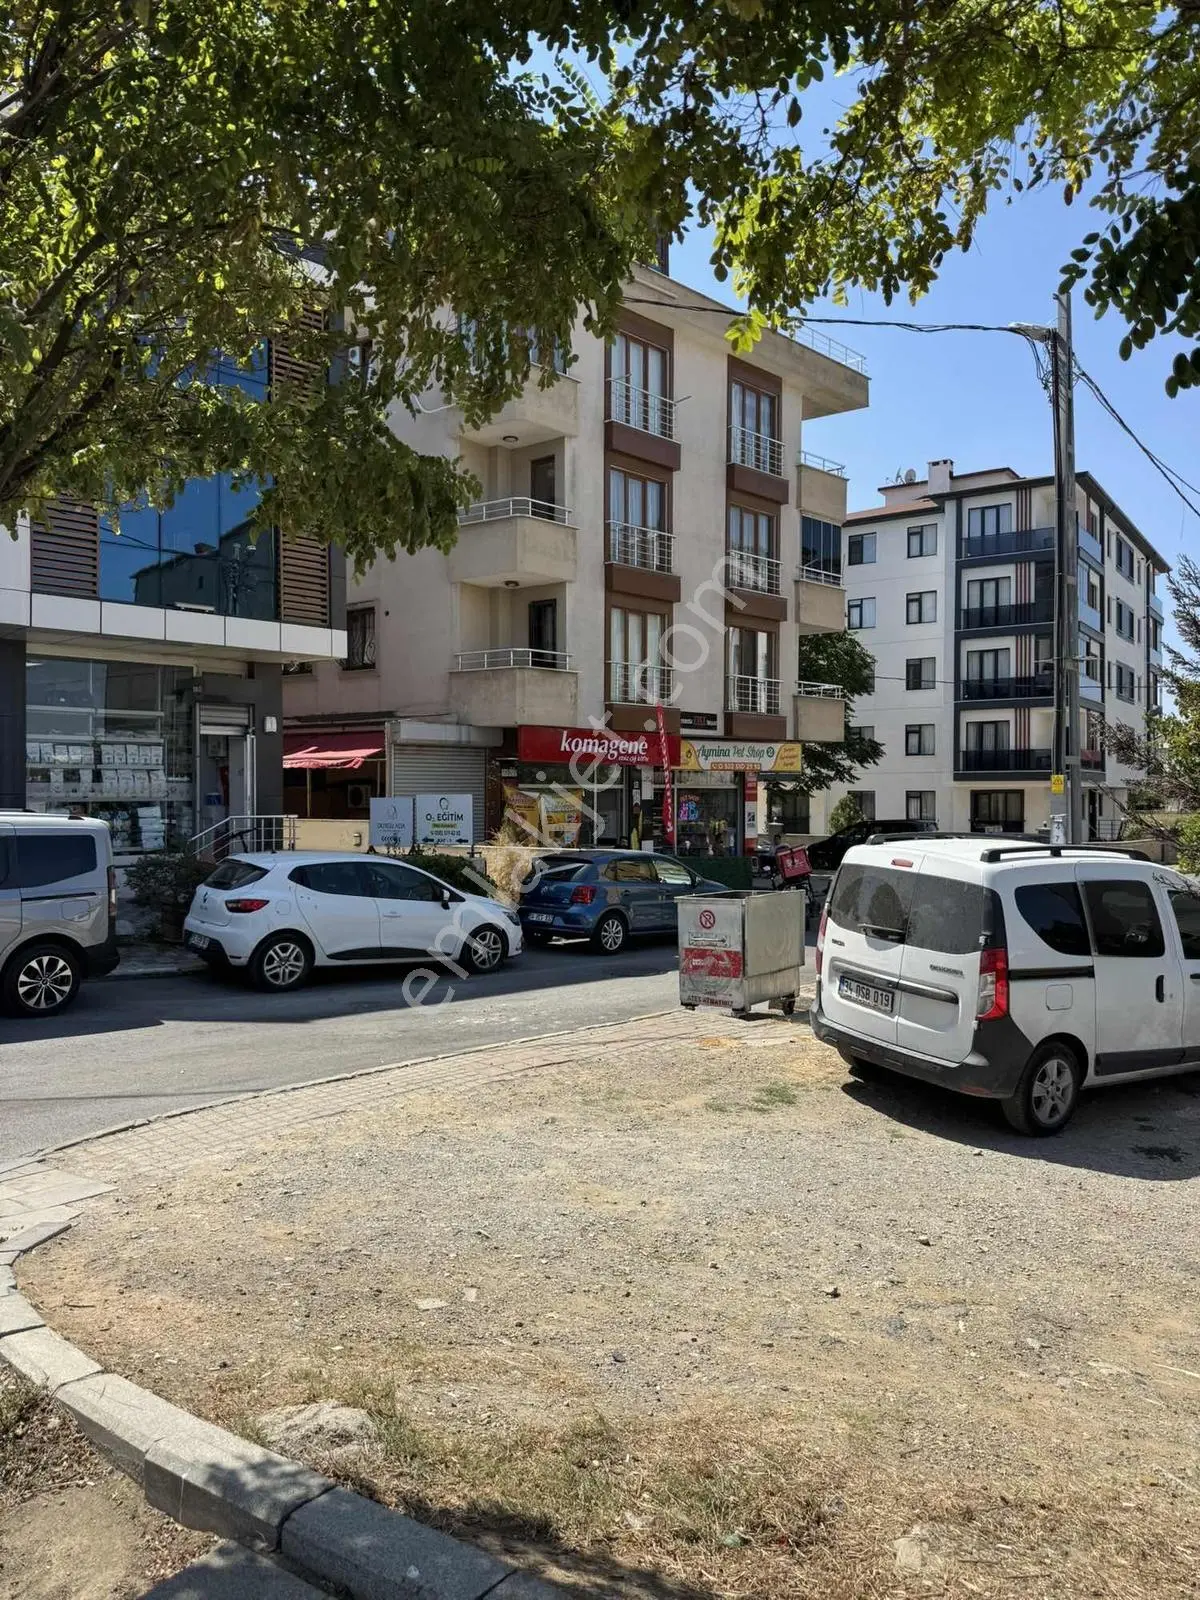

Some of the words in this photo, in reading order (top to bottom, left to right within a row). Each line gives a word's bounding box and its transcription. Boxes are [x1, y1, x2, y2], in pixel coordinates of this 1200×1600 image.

[560, 730, 648, 760] komagene
[732, 745, 745, 757] Pet
[746, 745, 765, 760] Shop
[437, 811, 464, 822] EĞİTİM
[844, 980, 853, 994] 34
[873, 990, 890, 1007] 019
